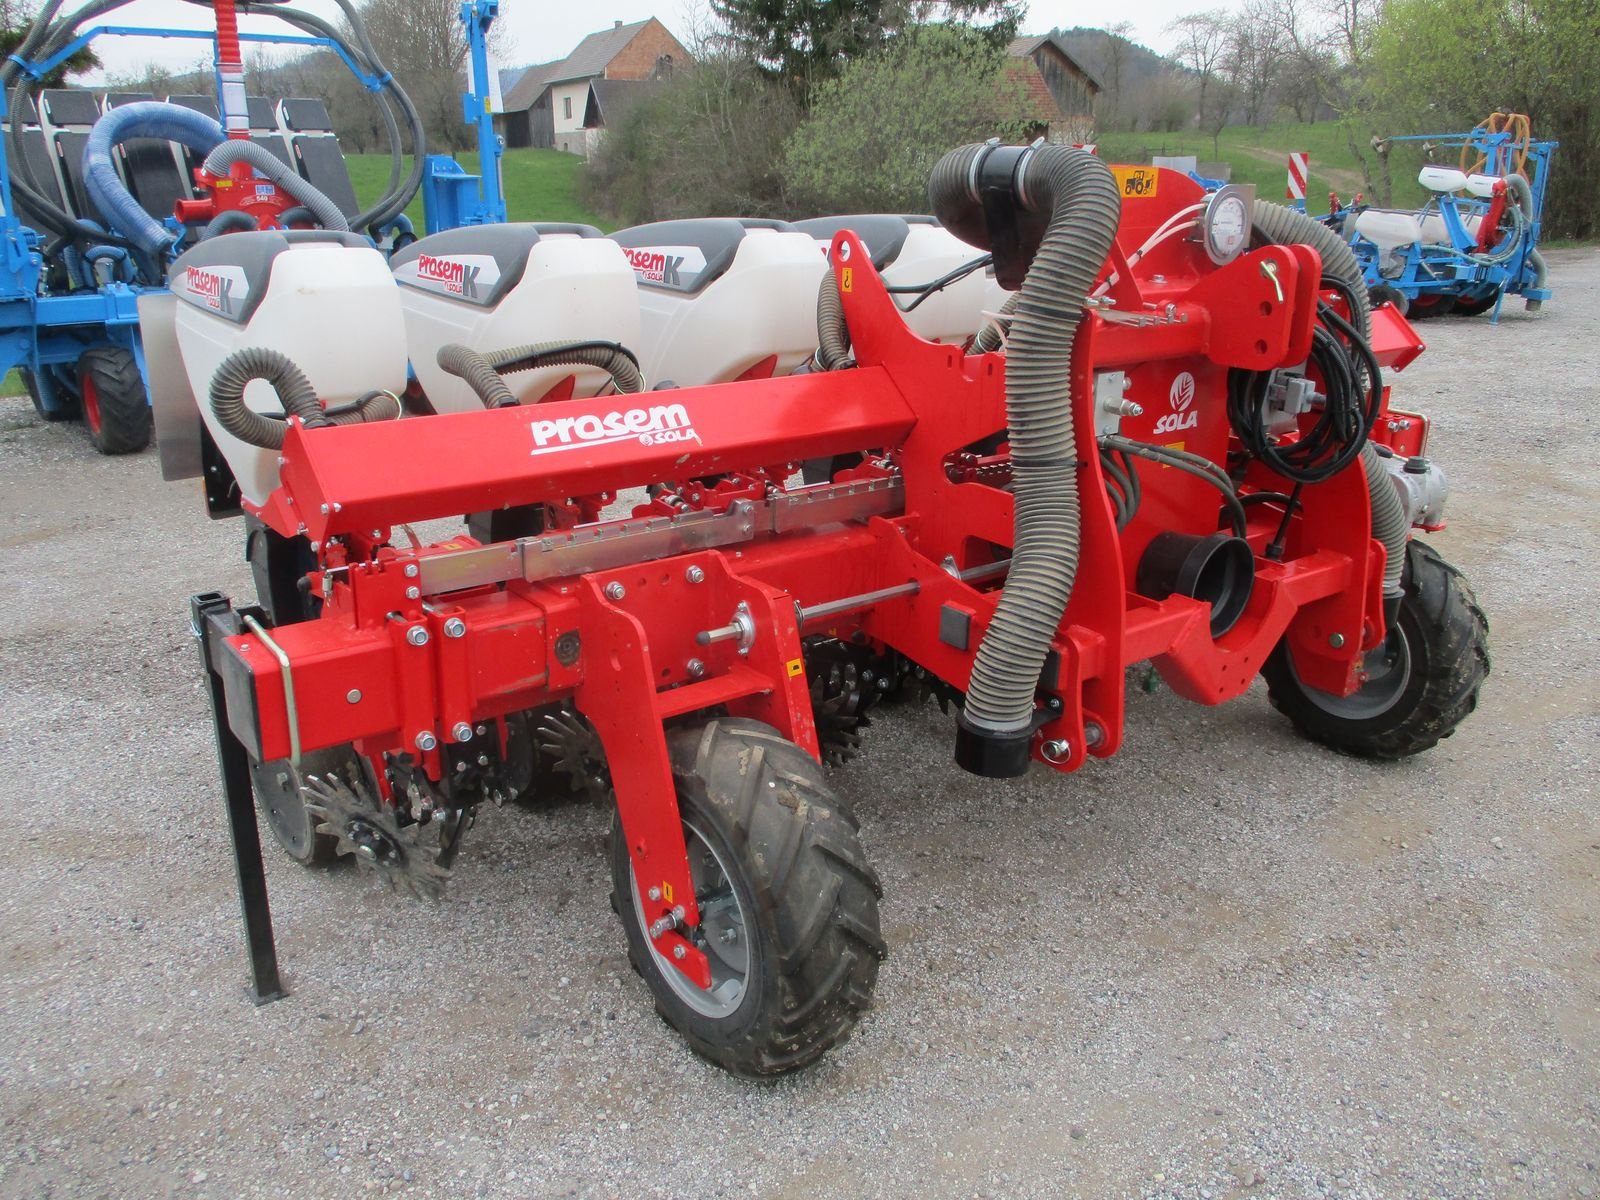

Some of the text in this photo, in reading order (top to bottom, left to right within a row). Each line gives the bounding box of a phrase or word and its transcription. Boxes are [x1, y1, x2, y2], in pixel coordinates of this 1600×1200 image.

[463, 264, 481, 298] K
[664, 255, 684, 285] K
[220, 276, 233, 314] K
[530, 403, 691, 446] prosem
[654, 428, 699, 444] SOLA
[1153, 410, 1198, 434] SOLA
